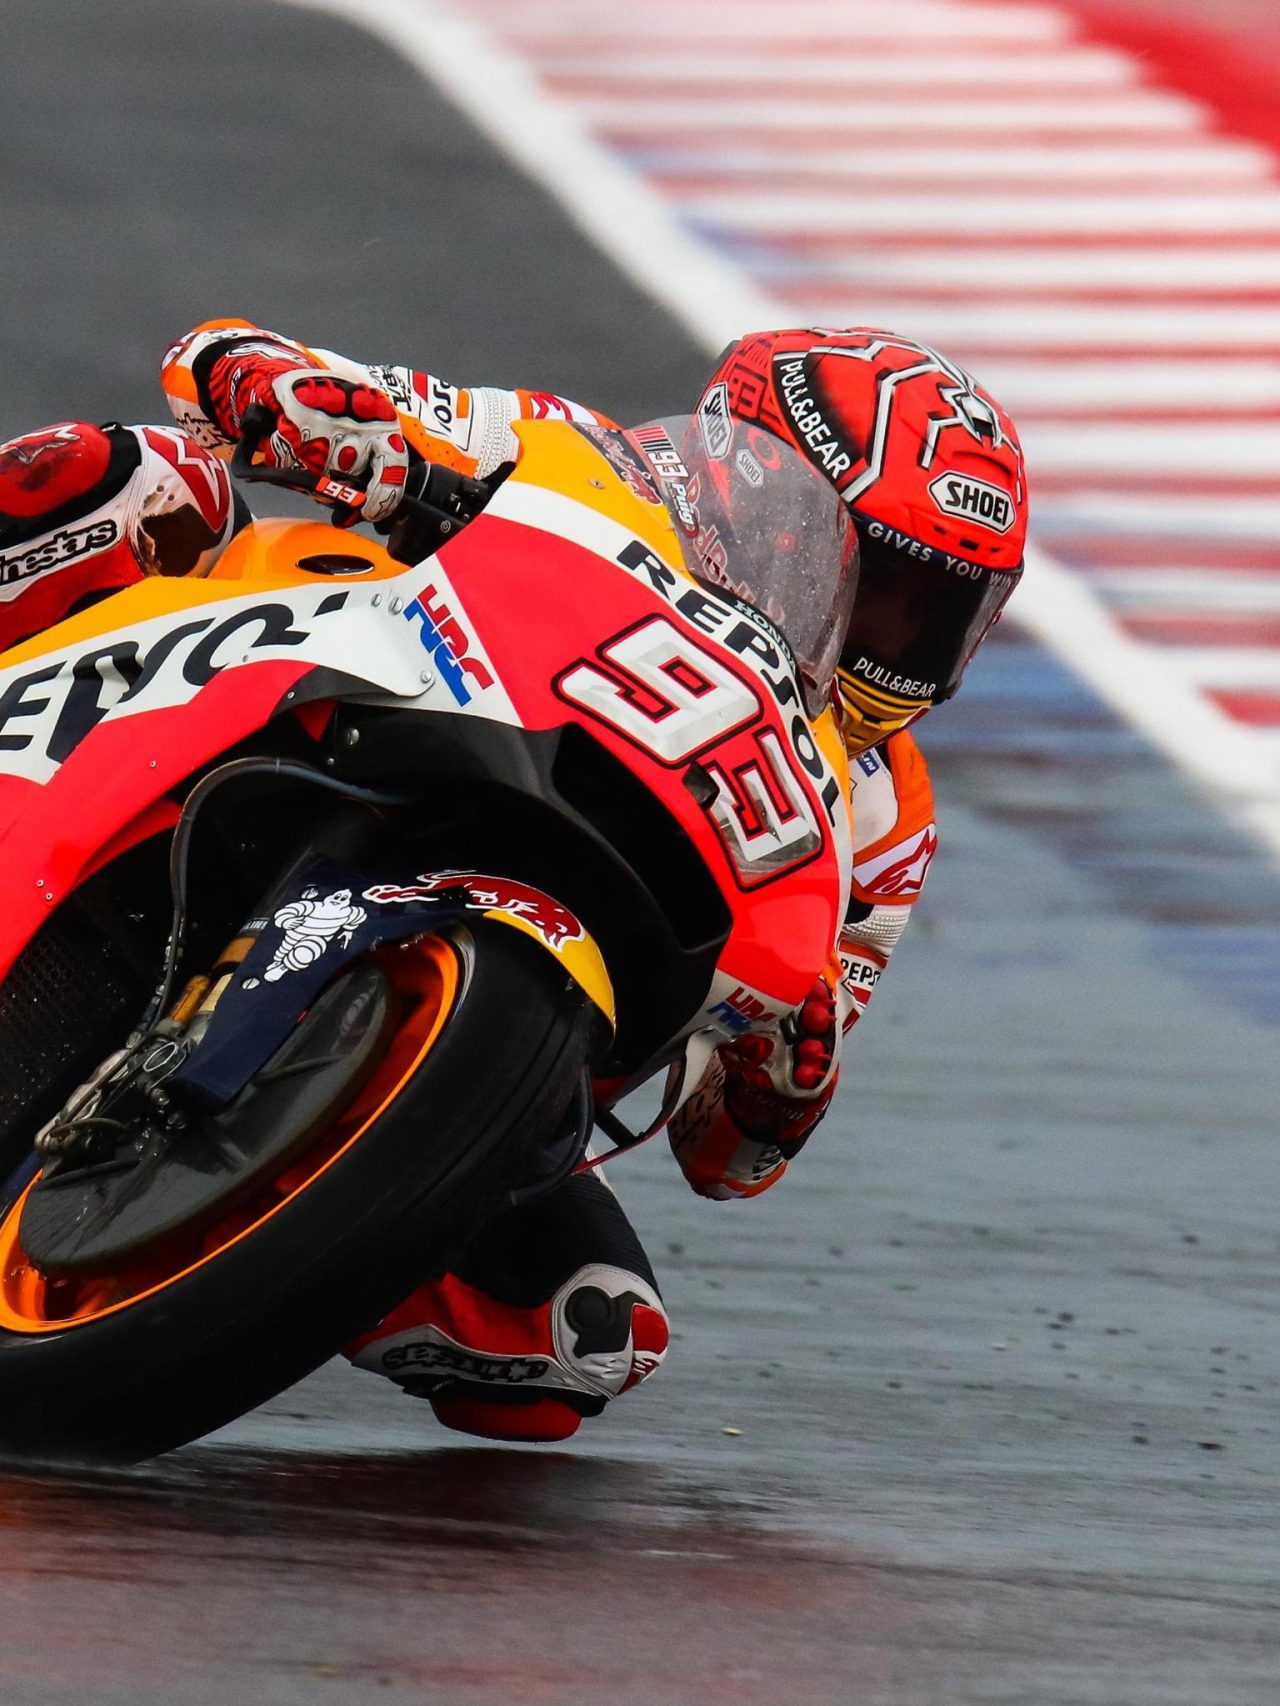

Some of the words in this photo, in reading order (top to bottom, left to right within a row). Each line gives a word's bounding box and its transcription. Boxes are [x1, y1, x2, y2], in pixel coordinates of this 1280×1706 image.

[779, 360, 851, 480] PULL&BEAR
[647, 450, 690, 478] 93
[738, 452, 763, 485] SHOEI
[322, 480, 359, 503] 93
[671, 482, 695, 525] Puig
[945, 480, 1010, 526] SHOEI
[867, 522, 933, 562] GIVES
[945, 554, 983, 580] YOU
[404, 584, 494, 707] HRC
[616, 539, 841, 829] REPSOL
[852, 656, 936, 698] PULL&BEAR
[550, 612, 823, 894] 93
